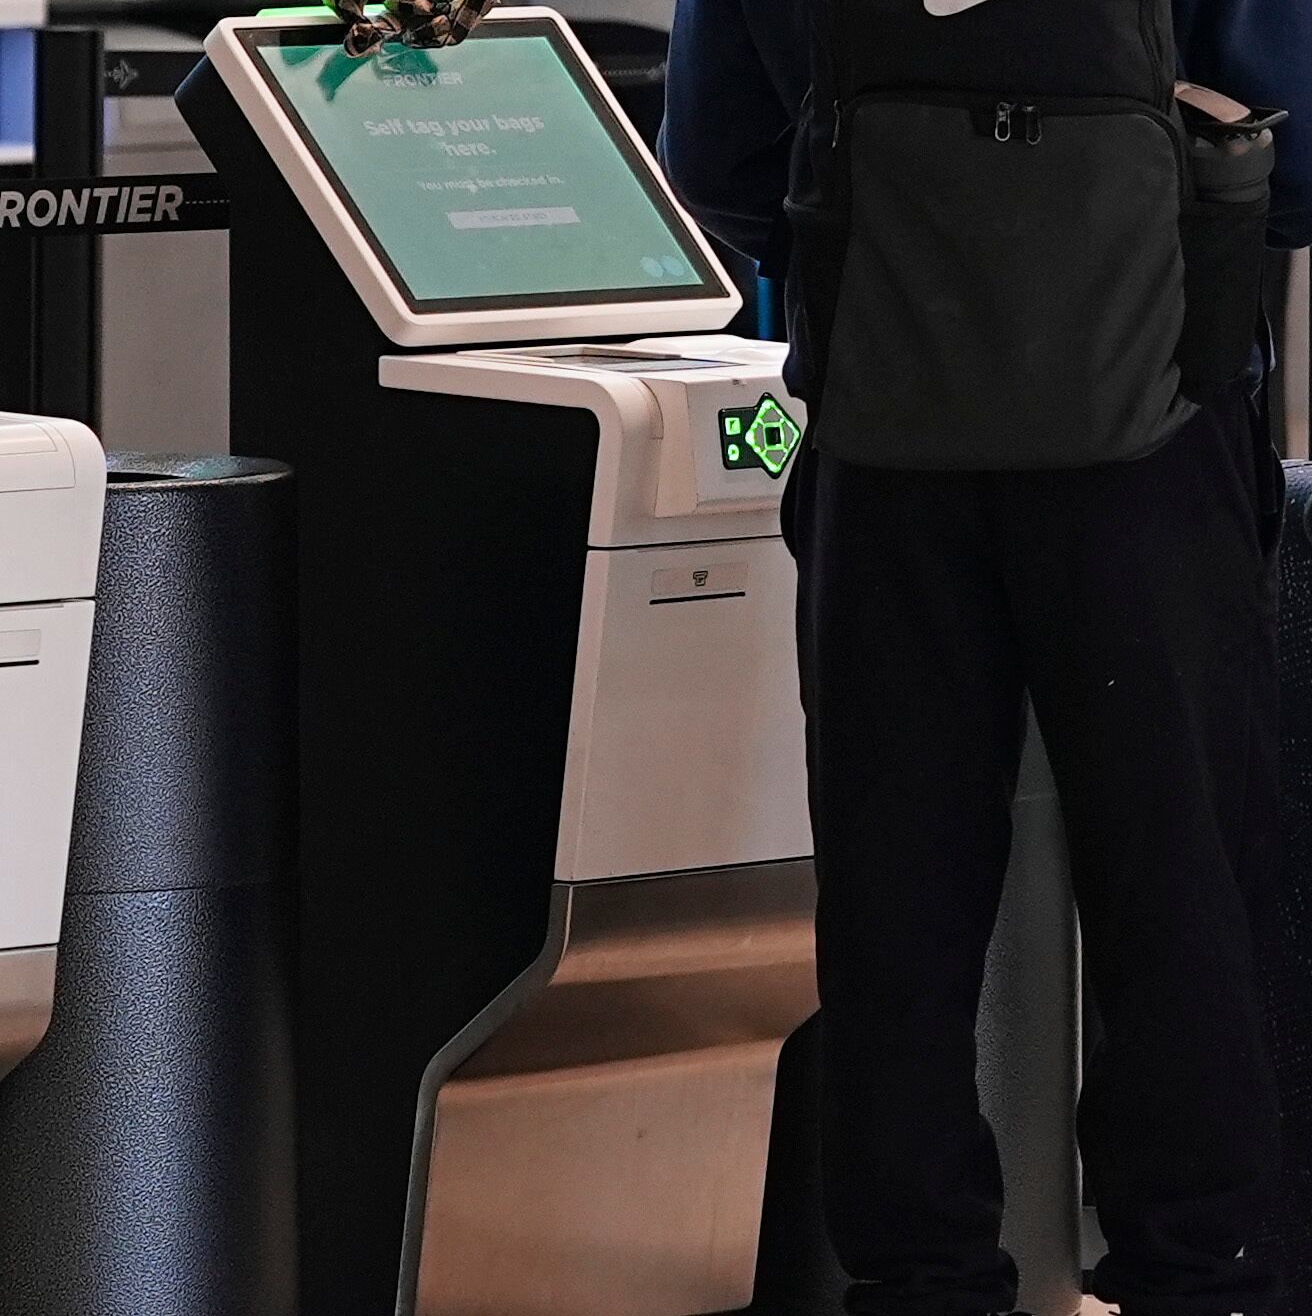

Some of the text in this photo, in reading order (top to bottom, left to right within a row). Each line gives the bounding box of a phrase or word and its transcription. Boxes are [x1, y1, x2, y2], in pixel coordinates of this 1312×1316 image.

[363, 114, 545, 136] Self tag your bags
[0, 185, 184, 228] RONTIER
